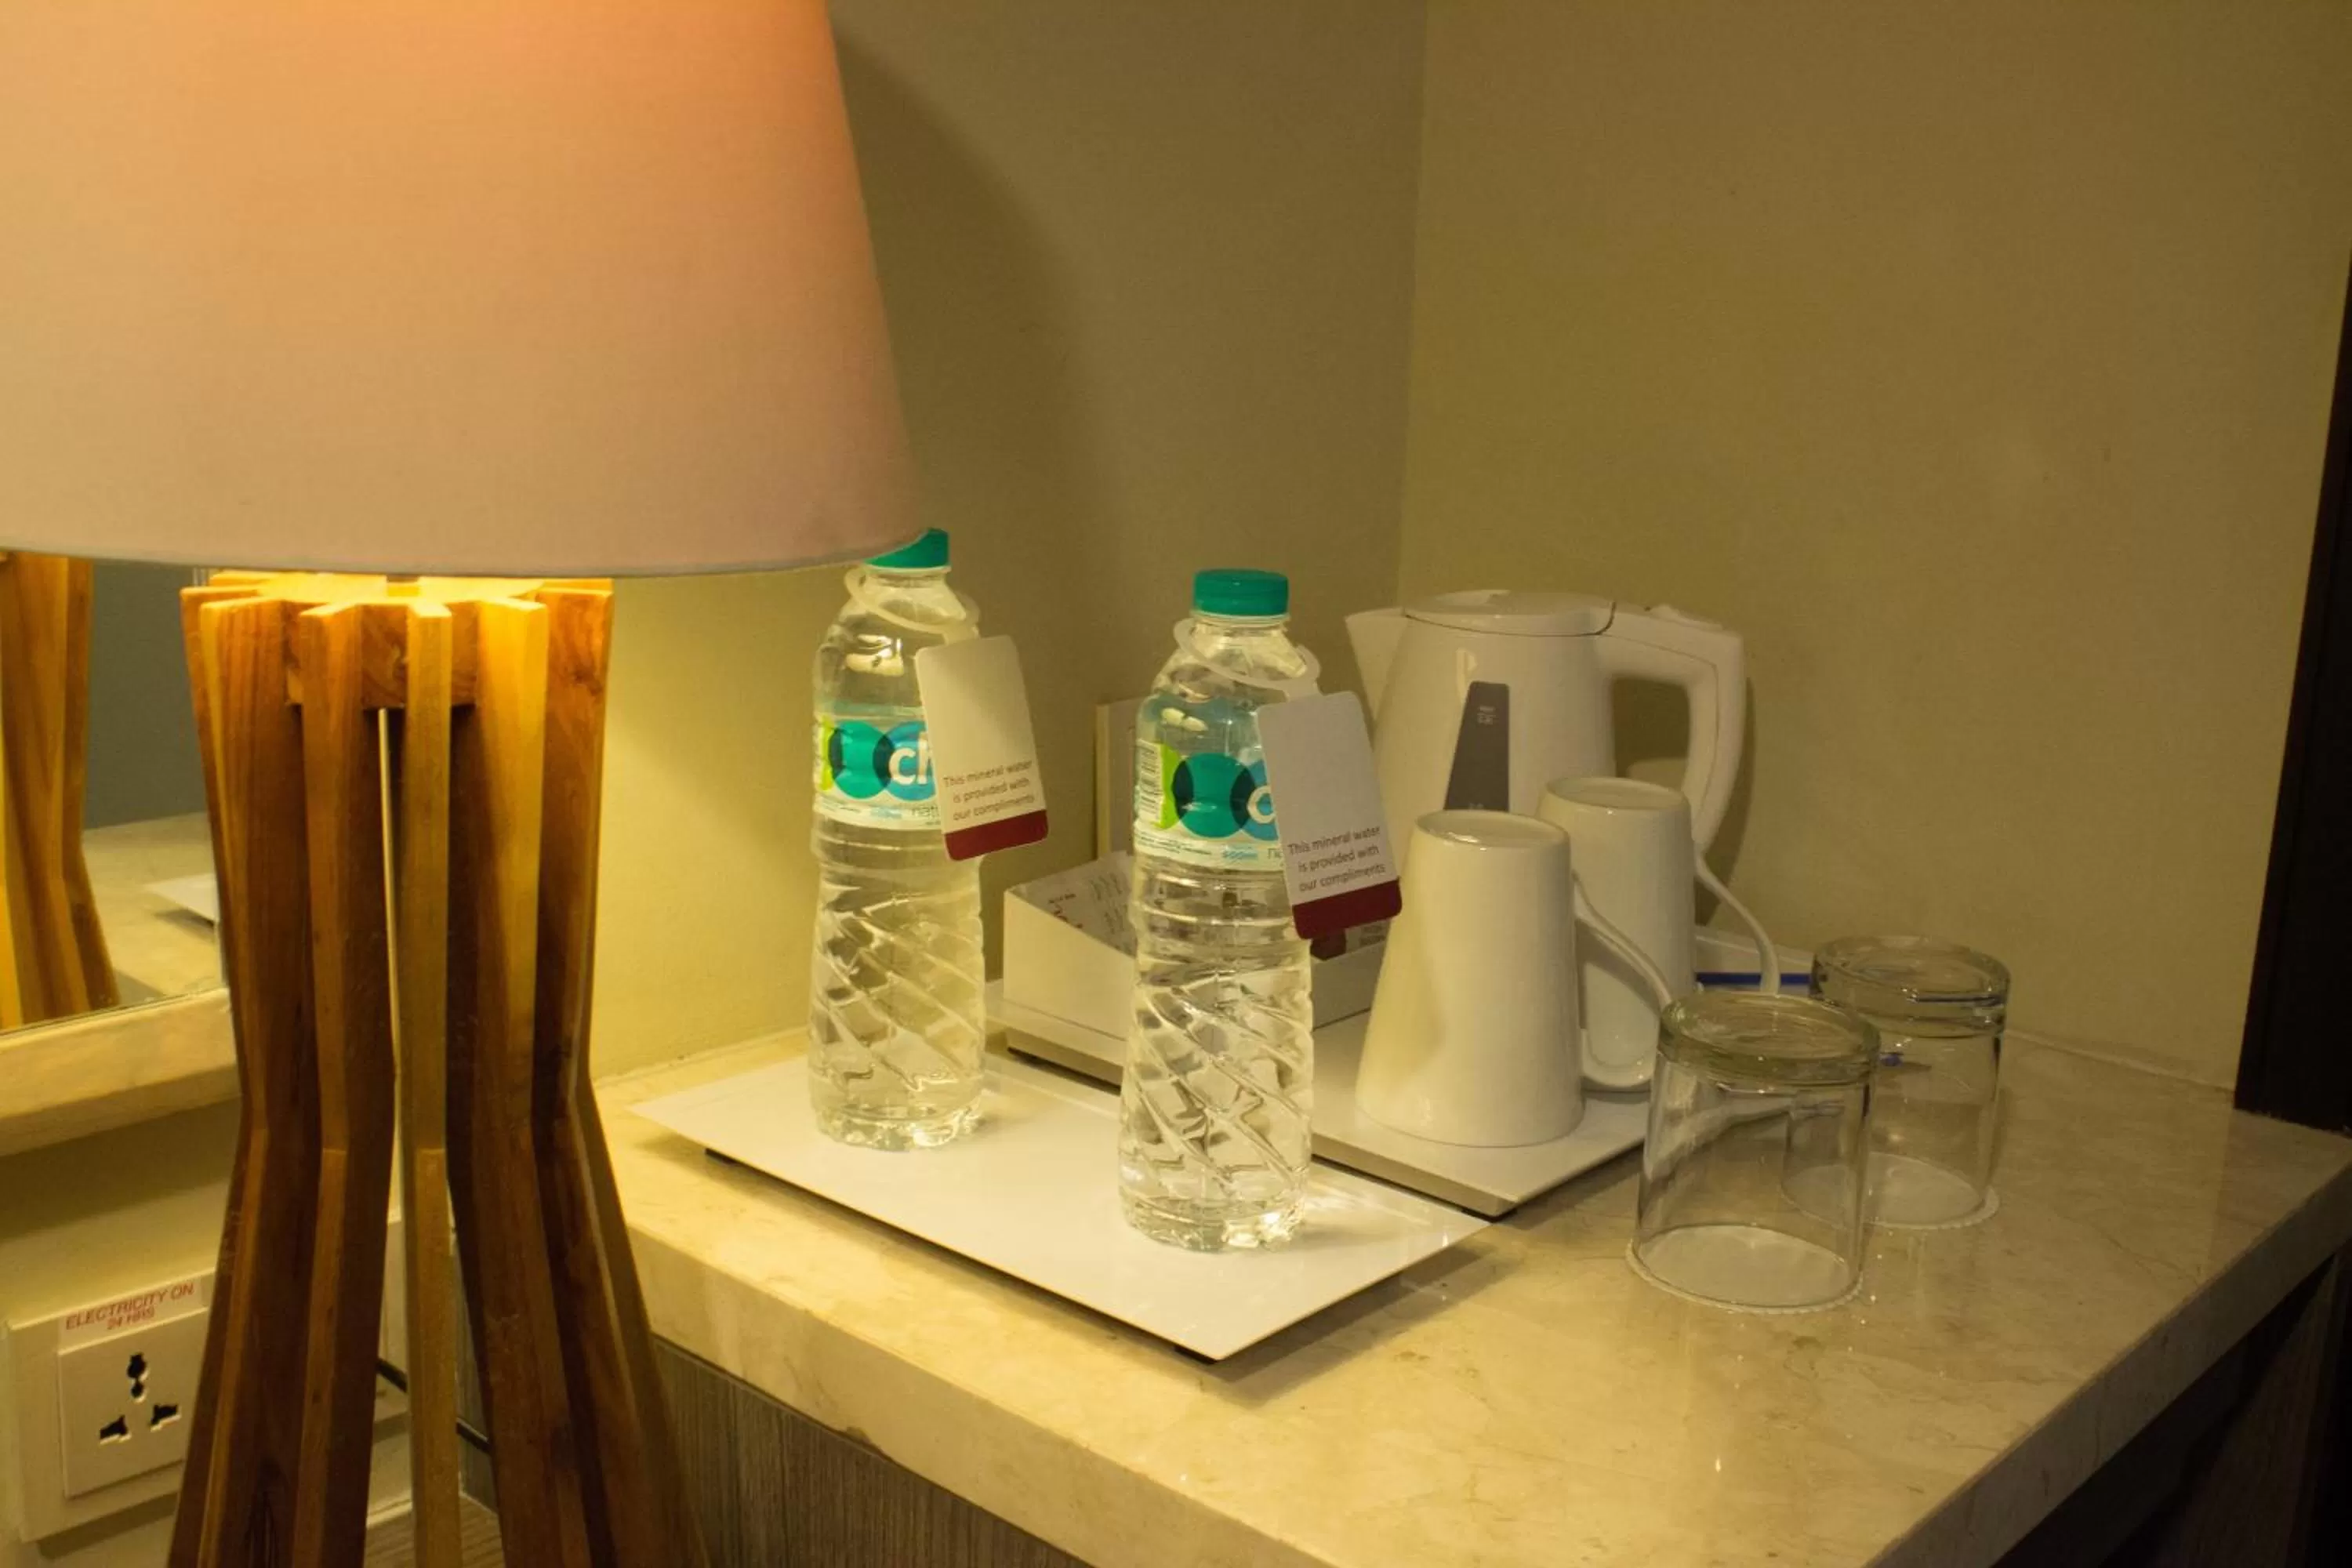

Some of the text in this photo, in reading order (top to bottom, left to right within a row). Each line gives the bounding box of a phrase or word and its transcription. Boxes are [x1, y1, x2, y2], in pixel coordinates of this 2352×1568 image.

[943, 759, 1033, 788] This mineral water
[953, 775, 1030, 804] is provided with
[953, 792, 1036, 821] our compliments
[1287, 826, 1381, 855] This mineral water
[1298, 844, 1380, 873] is provided with
[1299, 863, 1387, 892] our compliments
[66, 1279, 195, 1330] ELECTRICITY ON
